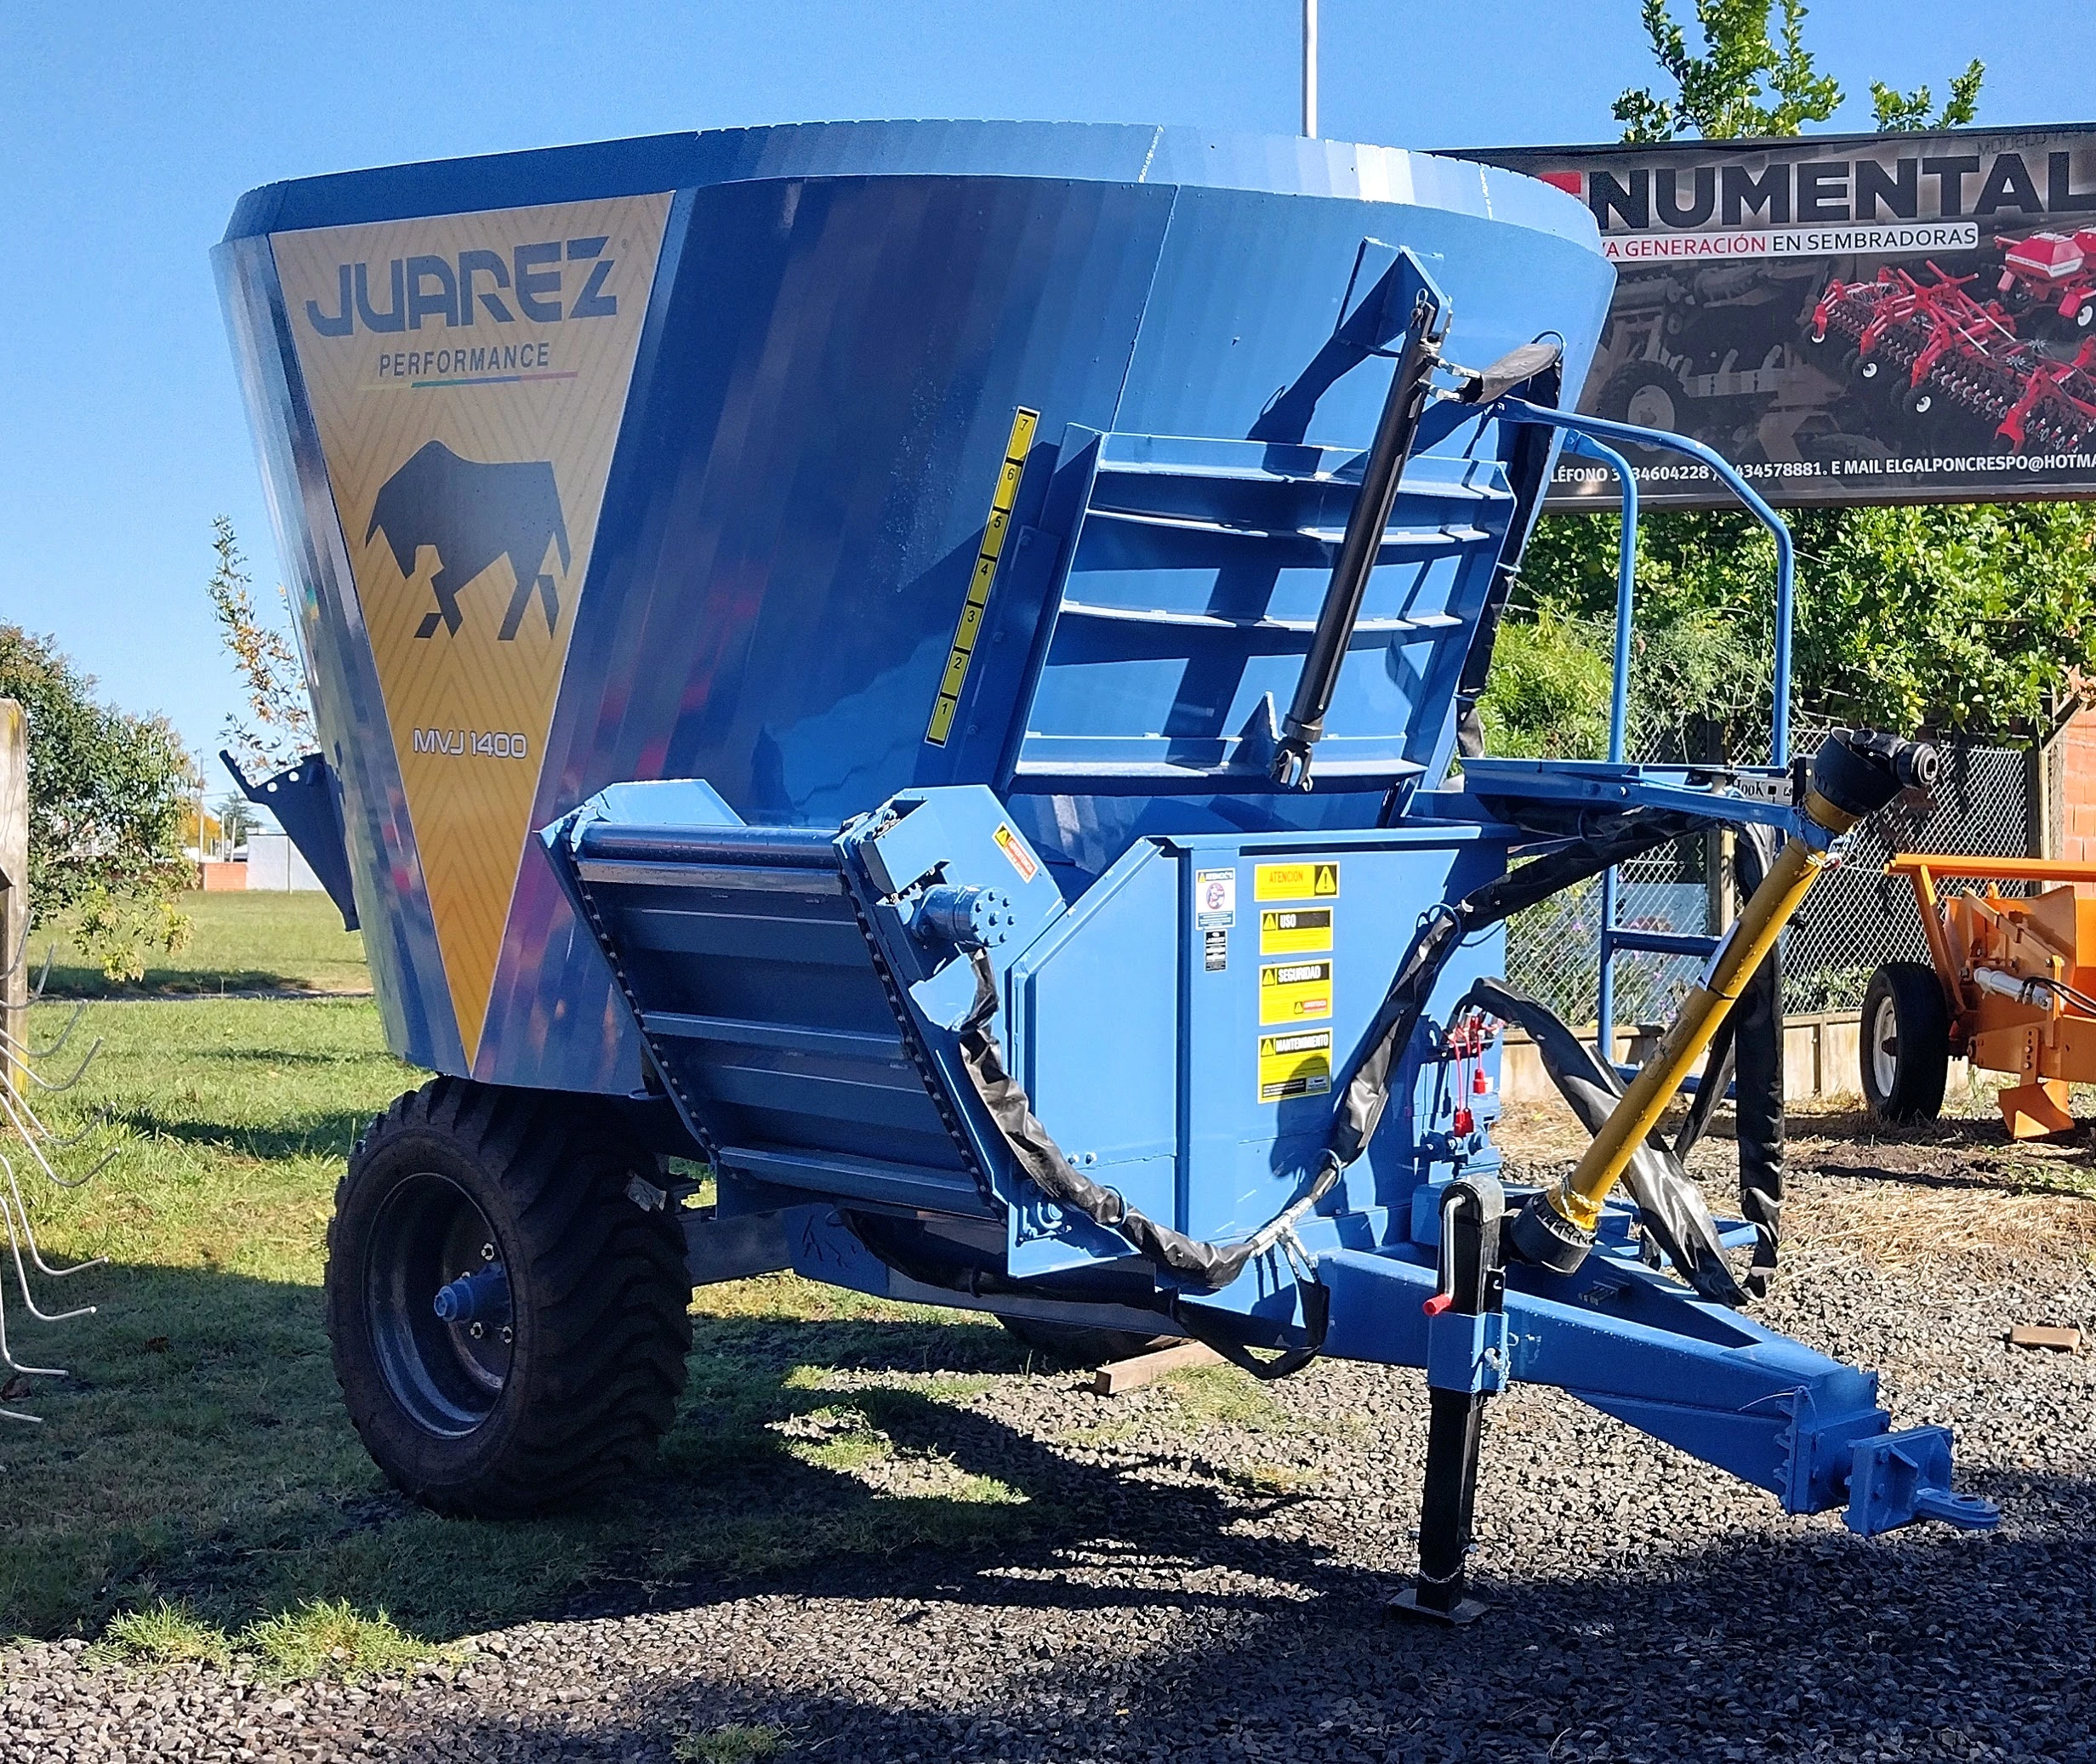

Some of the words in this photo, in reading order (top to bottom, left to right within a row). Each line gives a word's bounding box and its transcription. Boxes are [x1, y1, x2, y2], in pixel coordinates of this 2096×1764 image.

[1603, 241, 1620, 257] A
[1625, 234, 1766, 257] GENERACIÓN
[1773, 235, 1801, 253] EN
[1807, 228, 1976, 251] SEMBRADORAS
[305, 236, 618, 337] JUAREZ
[379, 342, 550, 377] PERFORMANCE
[1019, 418, 1028, 431] 7
[1007, 468, 1016, 481] 6
[1611, 465, 1709, 482] 334604228
[1736, 462, 1828, 479] 434578881.
[1831, 460, 1841, 475] E
[1844, 459, 1883, 475] MAIL
[994, 515, 1002, 528] 5
[981, 563, 988, 576] 4
[967, 610, 976, 623] 3
[954, 657, 962, 669] 2
[941, 703, 948, 714] 1
[413, 728, 464, 754] MVJ
[470, 731, 527, 759] 1400
[1279, 913, 1296, 929] USO
[1278, 965, 1321, 983] SEGURIDAD
[1276, 1033, 1329, 1053] MANTENIMIENTO
